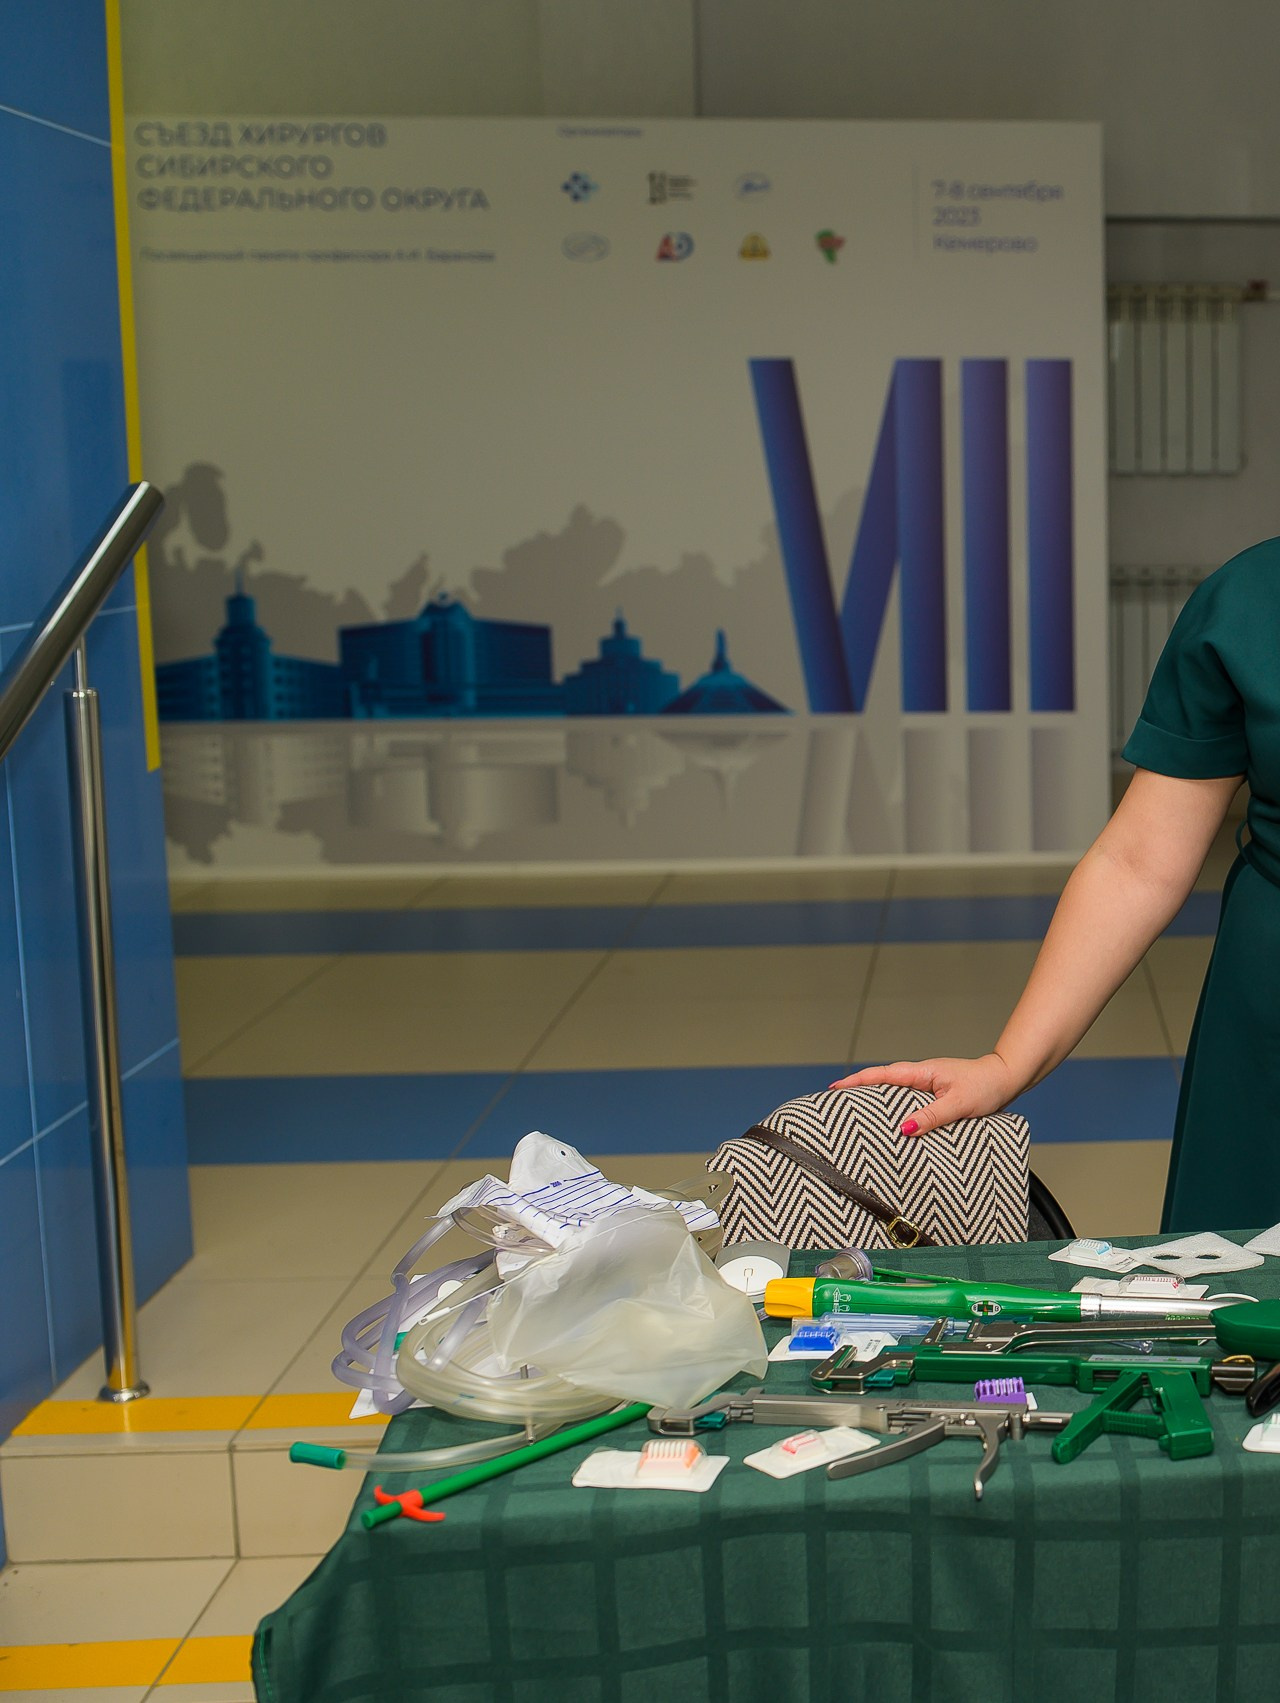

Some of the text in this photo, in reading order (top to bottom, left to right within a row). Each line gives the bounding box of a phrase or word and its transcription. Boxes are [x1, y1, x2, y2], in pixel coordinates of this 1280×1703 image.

[134, 122, 388, 148] СЪЕЗД ХИРУРГОВ
[135, 153, 334, 180] СИБИРСКОГО
[137, 185, 491, 213] ФЕДЕРАЛЬНОГО ОКРУГА
[966, 178, 1065, 203] сентября
[932, 204, 982, 227] 2023
[933, 233, 1040, 257] Кемерово
[748, 358, 1077, 713] VIII
